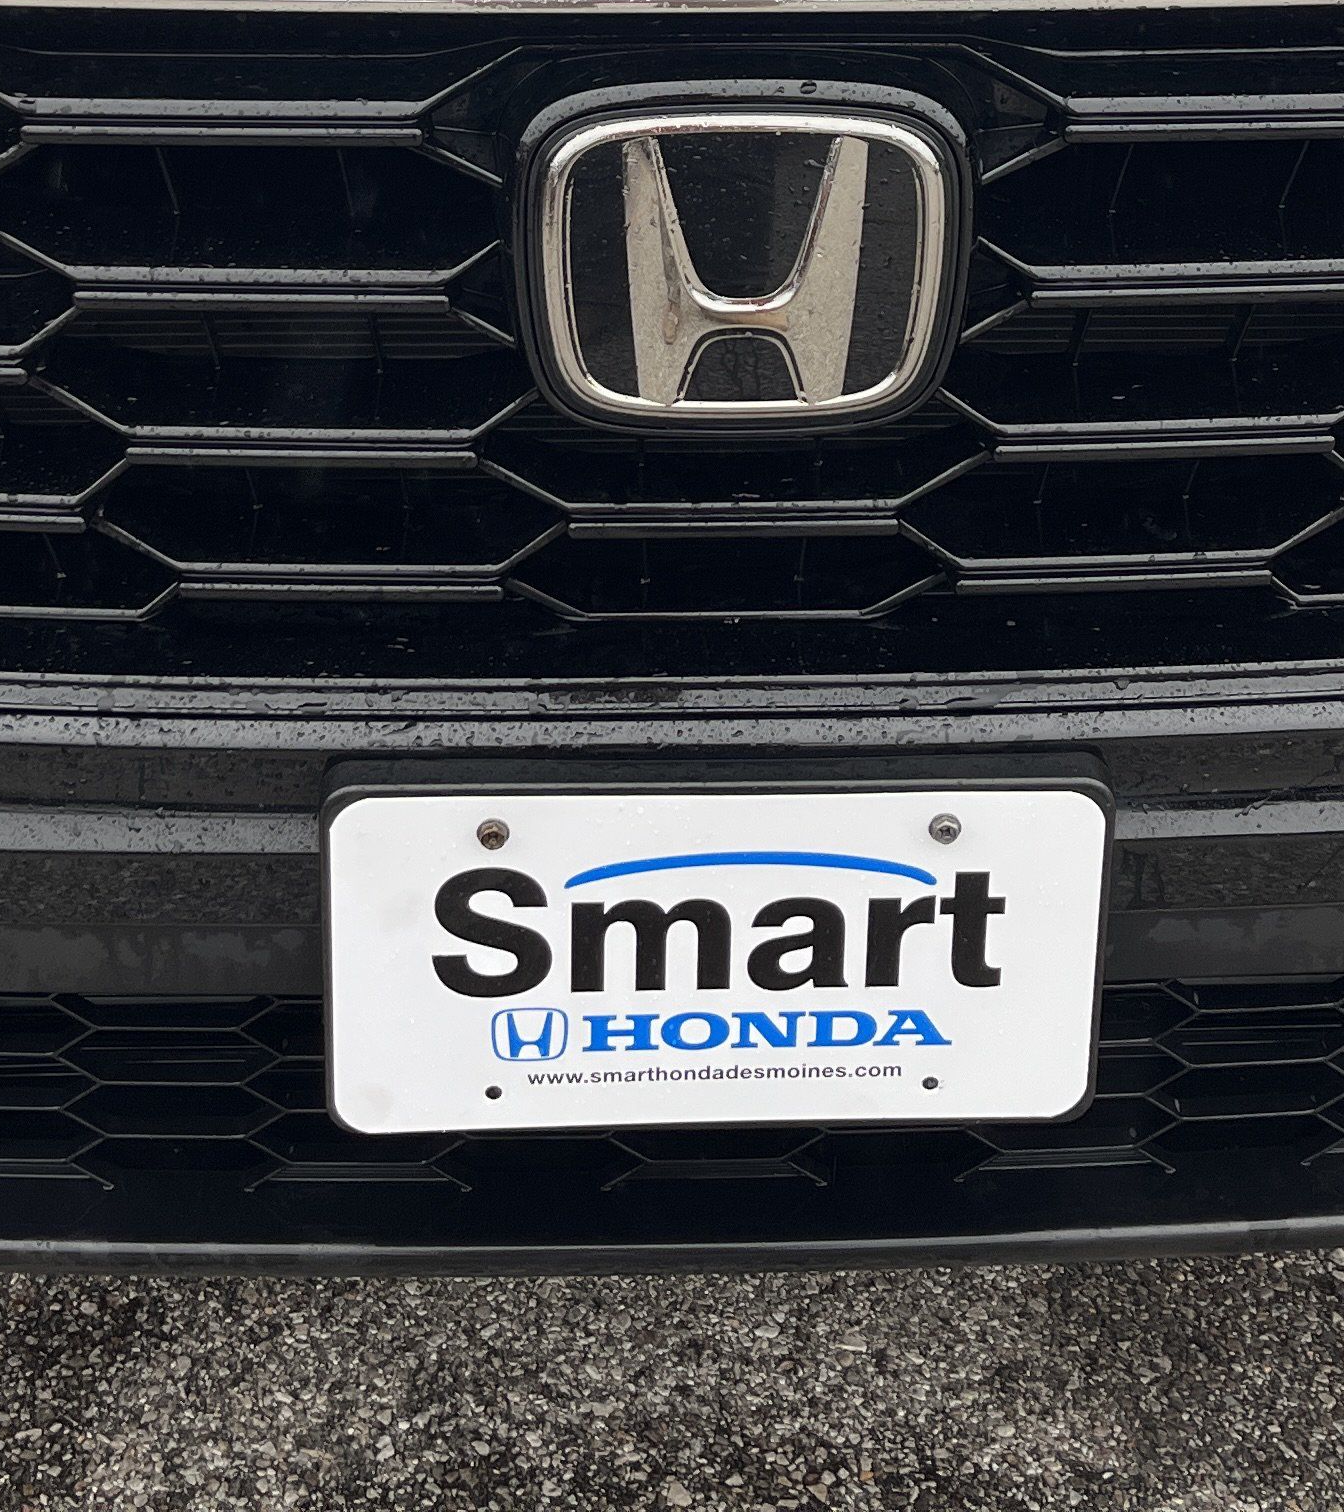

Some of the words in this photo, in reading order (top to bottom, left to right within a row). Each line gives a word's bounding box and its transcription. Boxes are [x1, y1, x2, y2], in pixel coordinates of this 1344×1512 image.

[431, 867, 1005, 998] Smart
[582, 1008, 952, 1053] HONDA
[527, 1062, 902, 1086] www.smarthondadesmoines.com
